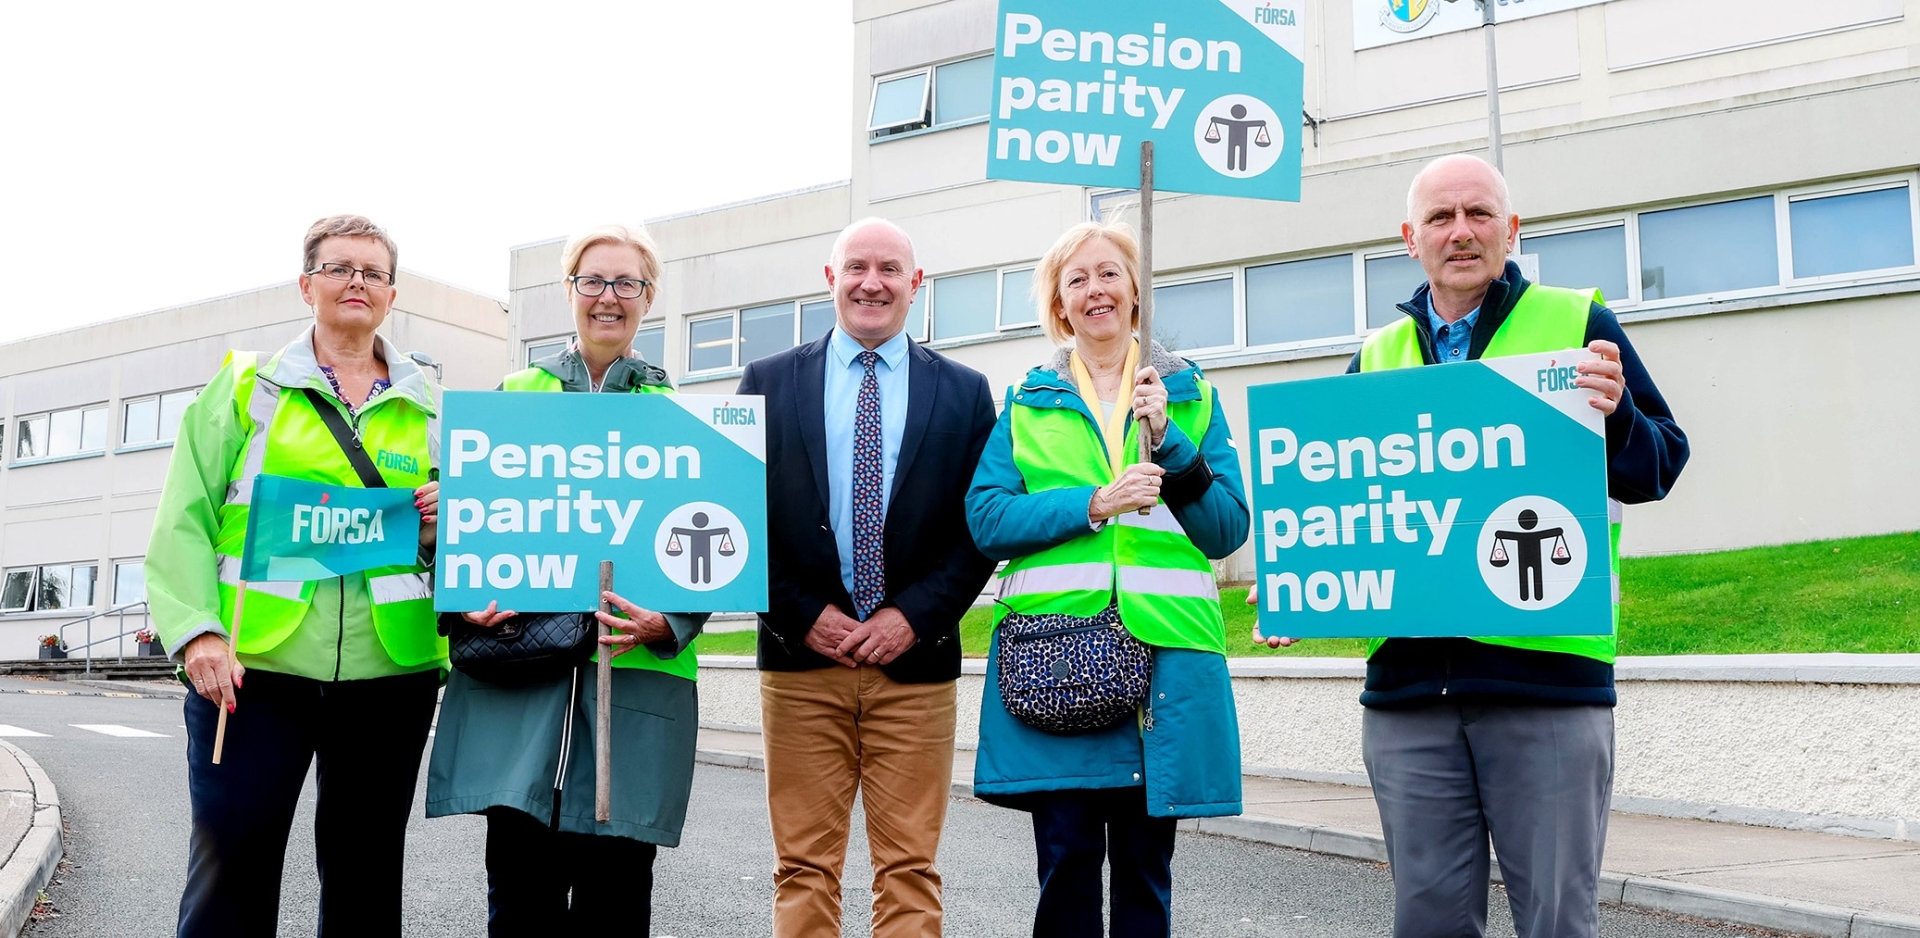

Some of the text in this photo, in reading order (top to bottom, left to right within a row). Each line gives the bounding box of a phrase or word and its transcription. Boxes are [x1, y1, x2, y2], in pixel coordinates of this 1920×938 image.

[1254, 1, 1297, 27] FÓRSA
[1003, 12, 1242, 73] Pension
[998, 70, 1186, 129] parity
[995, 127, 1123, 167] now
[1537, 359, 1589, 393] FÓRS
[712, 401, 757, 426] FÓRSA
[448, 429, 701, 479] Pension
[1258, 413, 1526, 485] Pension
[291, 492, 385, 545] FÓRSA
[445, 484, 644, 545] parity
[1262, 484, 1462, 562] parity
[443, 553, 578, 589] now
[1265, 569, 1396, 612] now
